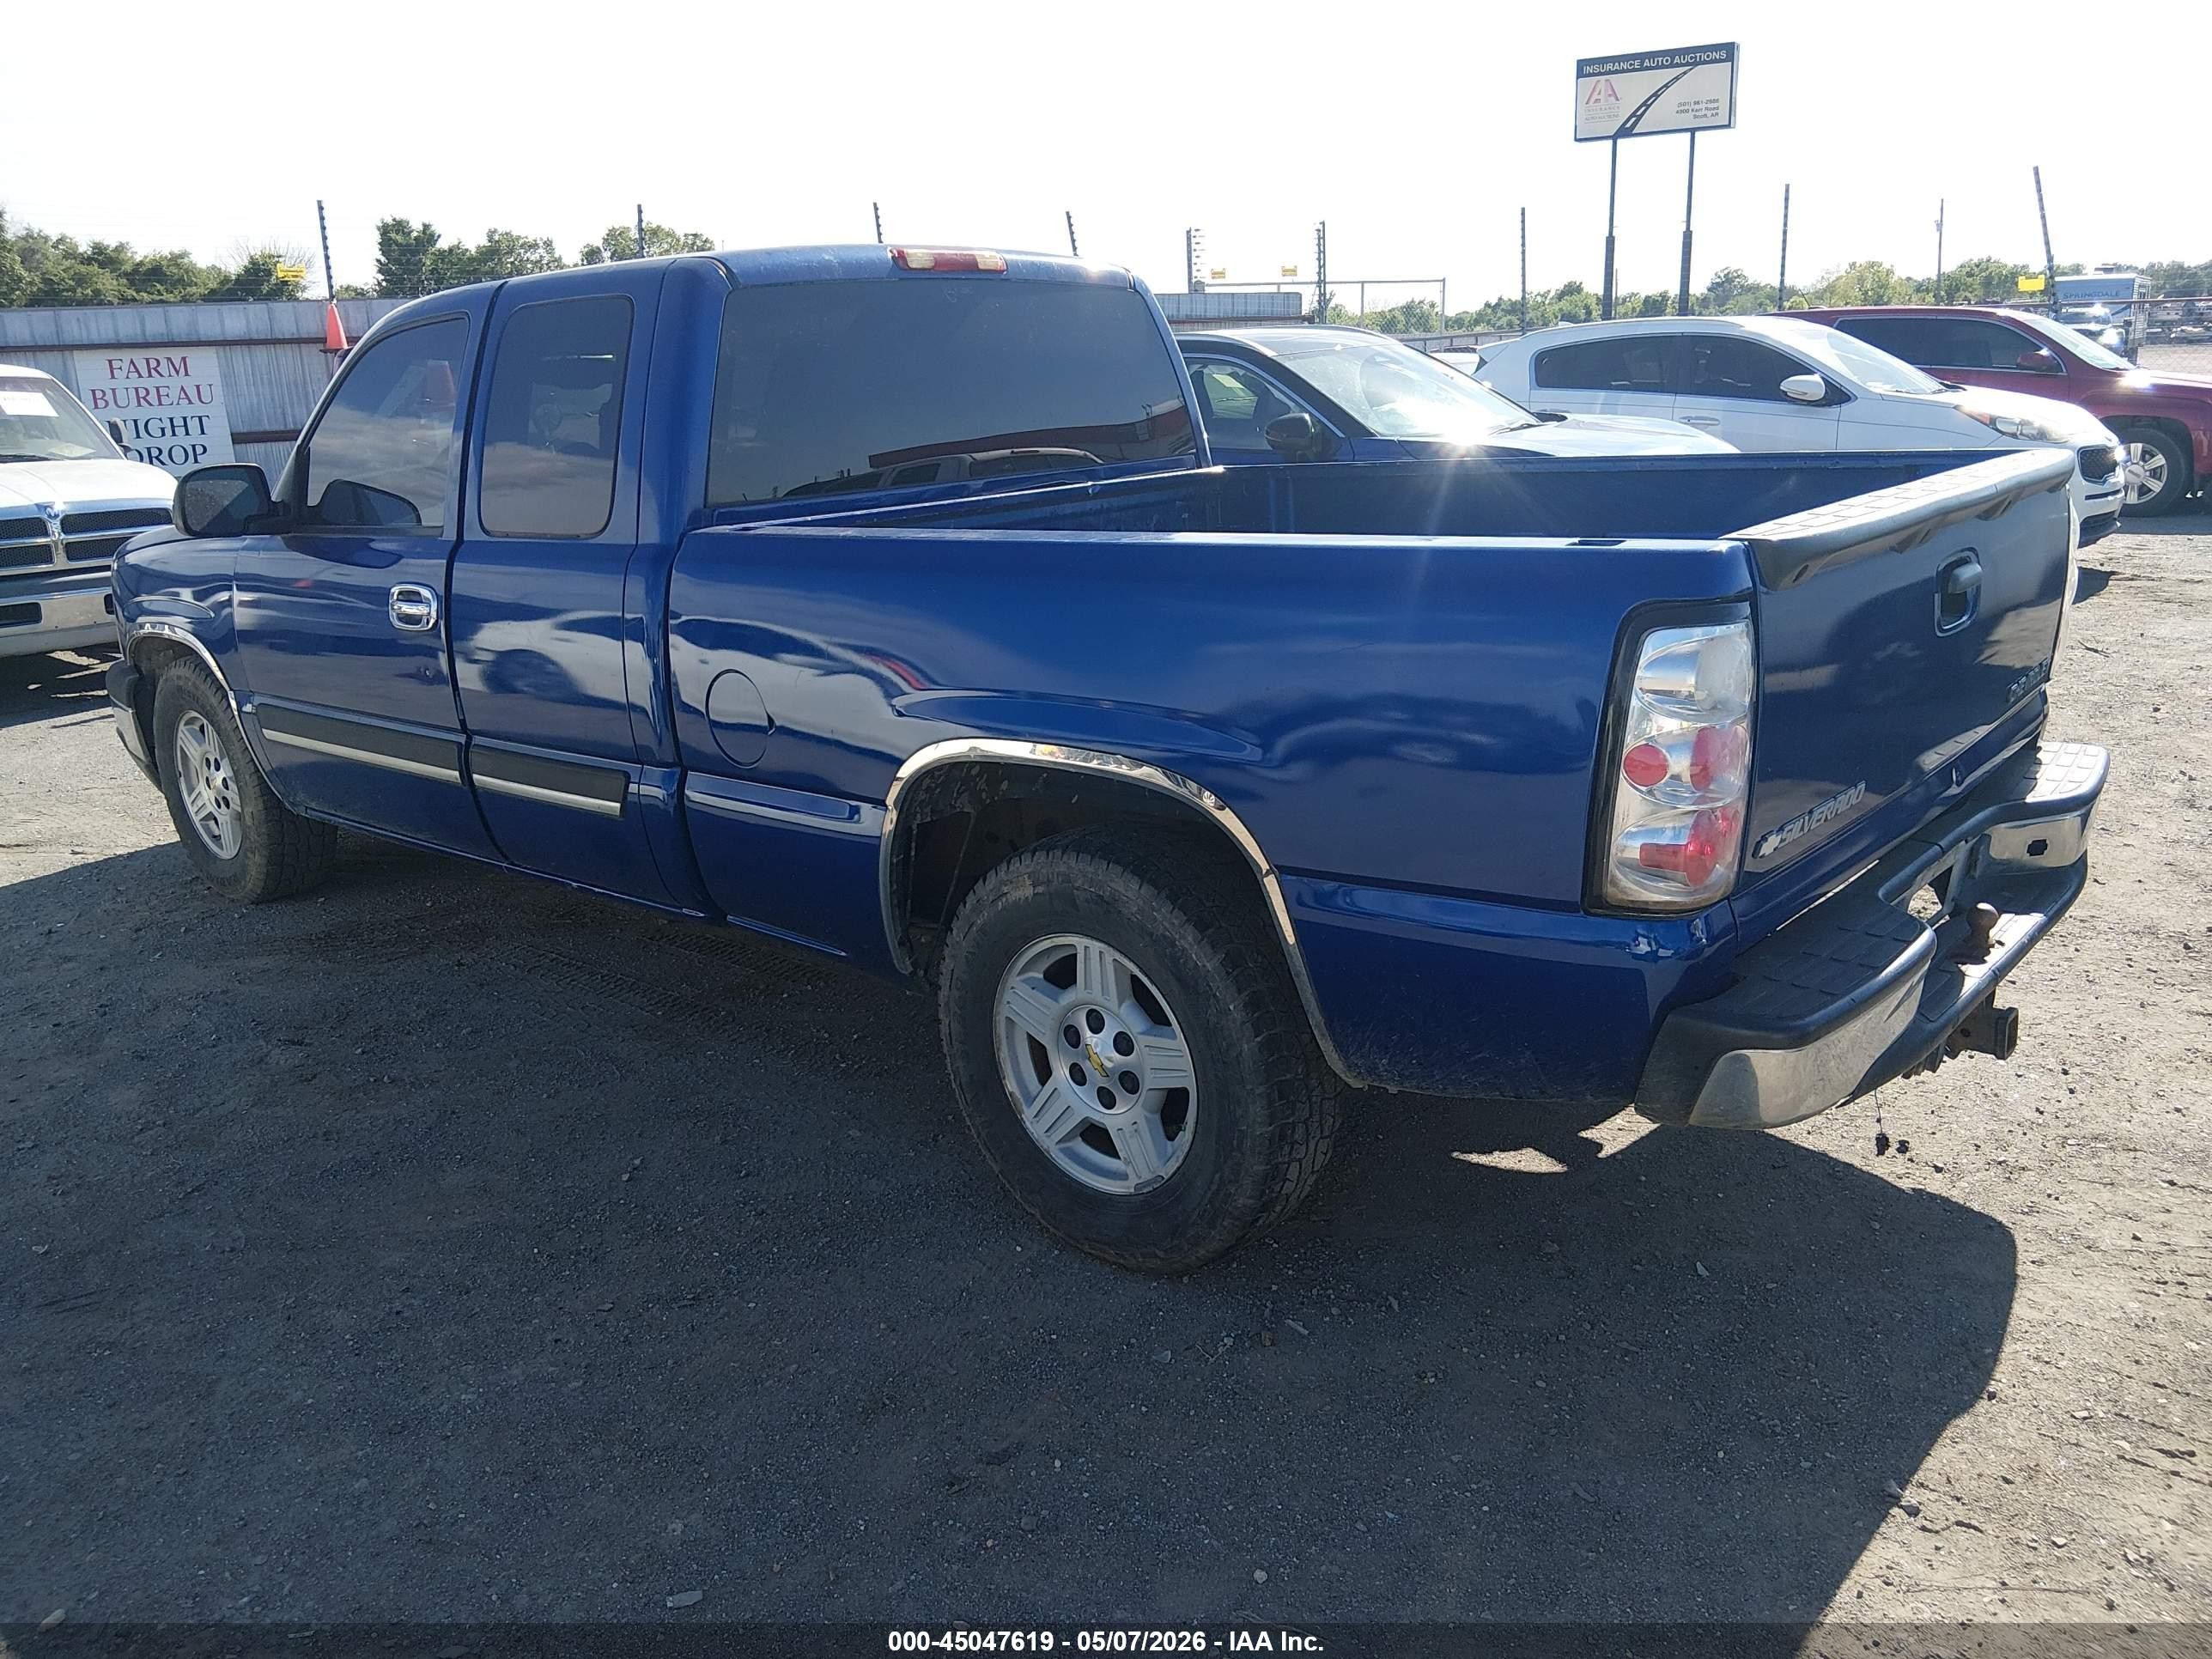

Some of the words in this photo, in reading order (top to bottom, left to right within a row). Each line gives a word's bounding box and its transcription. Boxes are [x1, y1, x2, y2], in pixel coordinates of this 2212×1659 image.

[1583, 59, 1641, 74] INSURANCE
[1644, 57, 1671, 67] AUTO
[1674, 51, 1727, 64] AUCTIONS
[106, 356, 191, 380] FARM
[89, 383, 214, 410] BUREAU
[1778, 781, 1866, 849] SILVERADO
